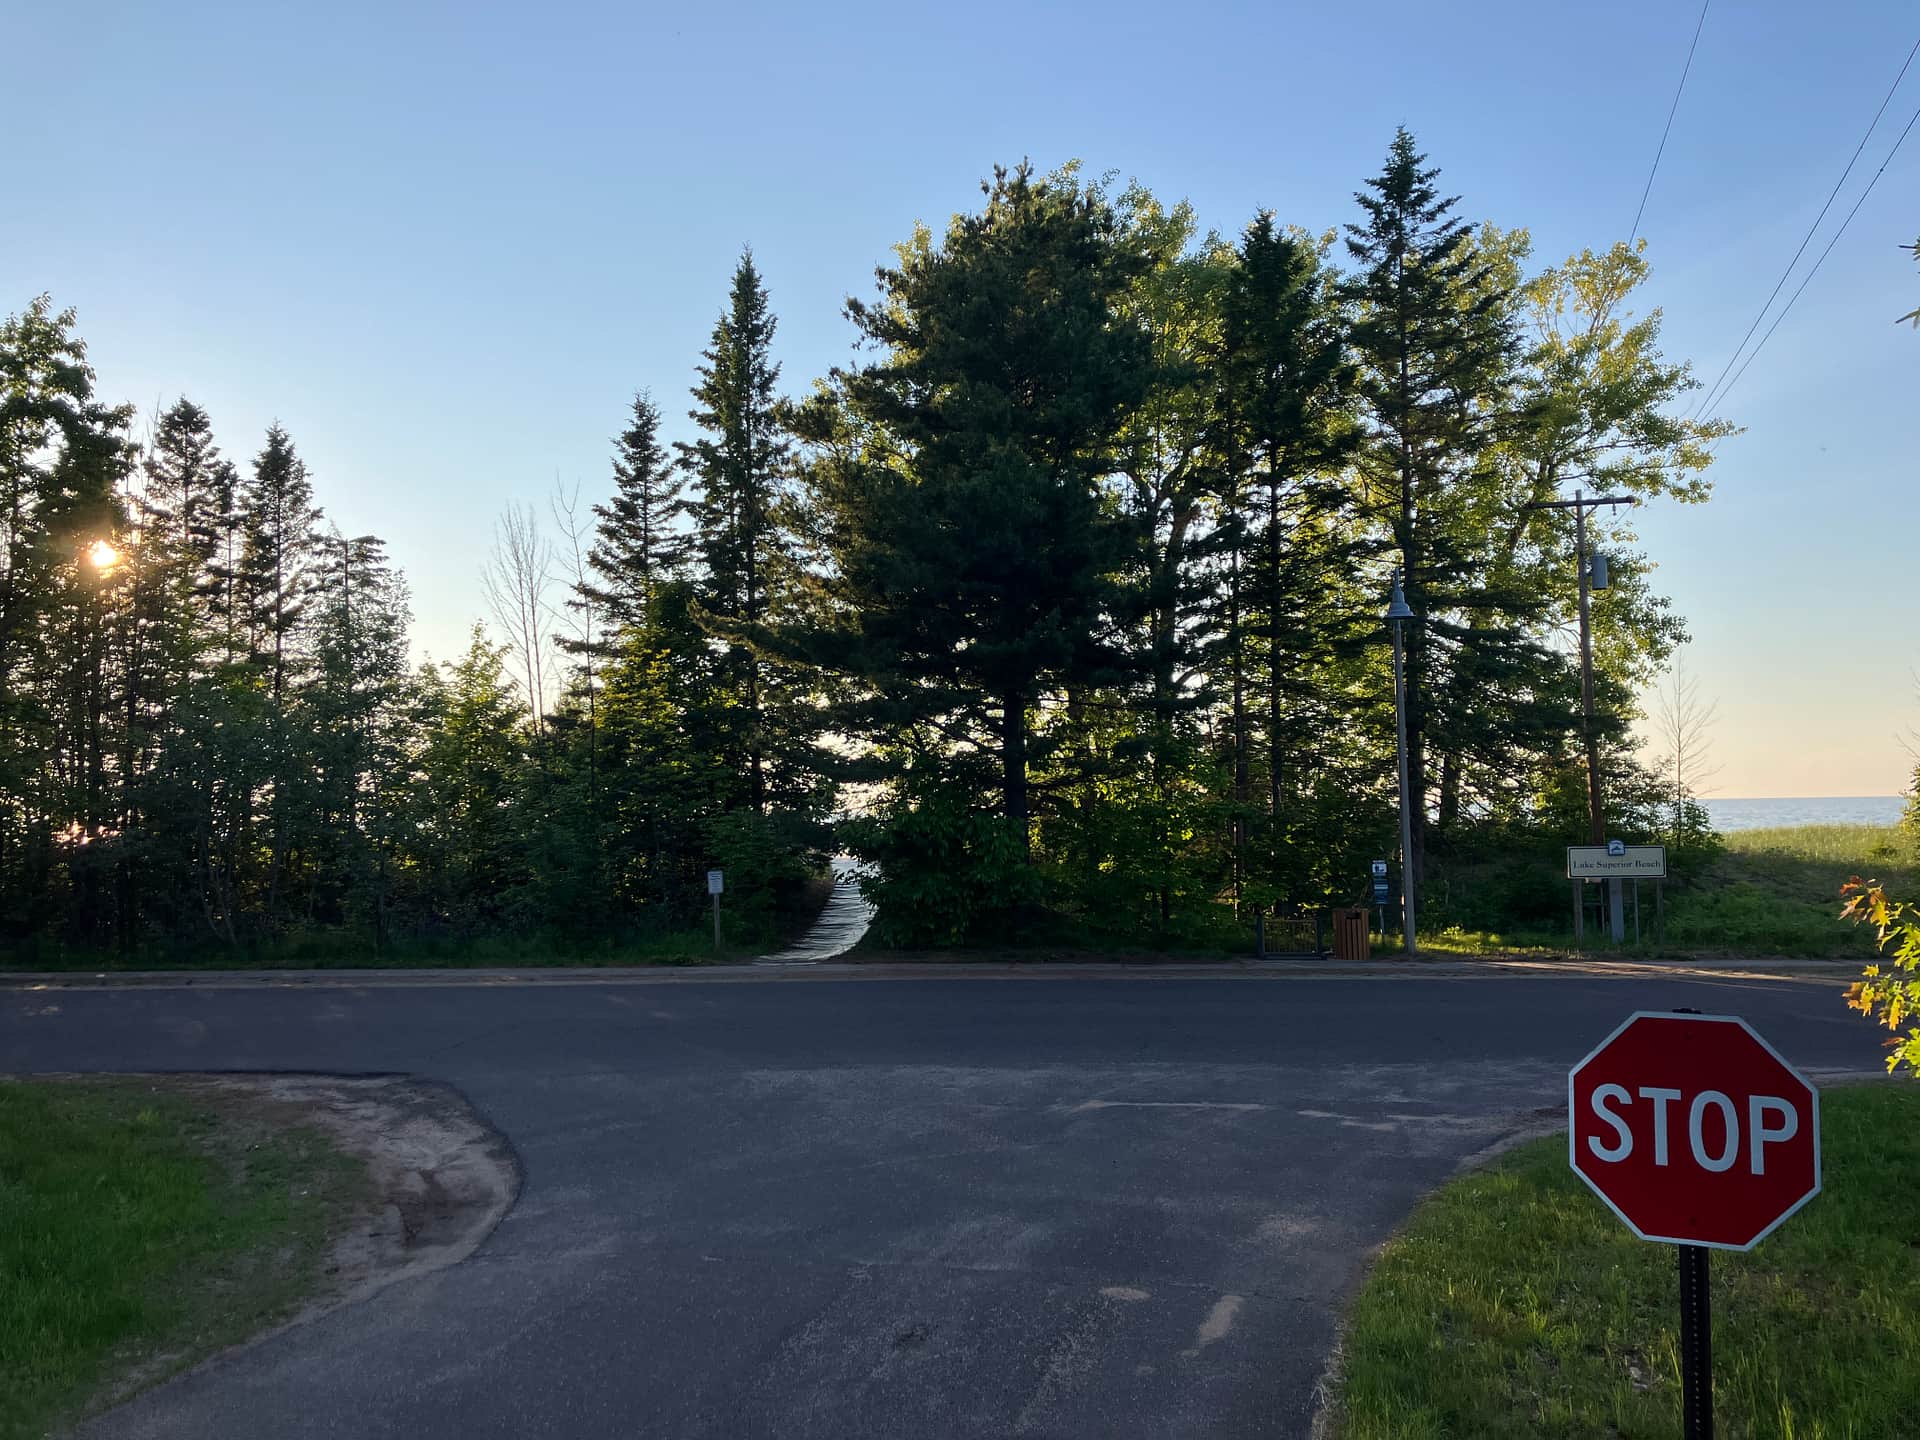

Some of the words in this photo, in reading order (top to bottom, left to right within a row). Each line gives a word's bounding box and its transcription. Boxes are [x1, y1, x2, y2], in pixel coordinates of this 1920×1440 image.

[1573, 860, 1595, 869] Lake
[1597, 860, 1633, 870] Superior
[1635, 860, 1661, 868] Beach
[1588, 1083, 1799, 1175] STOP
